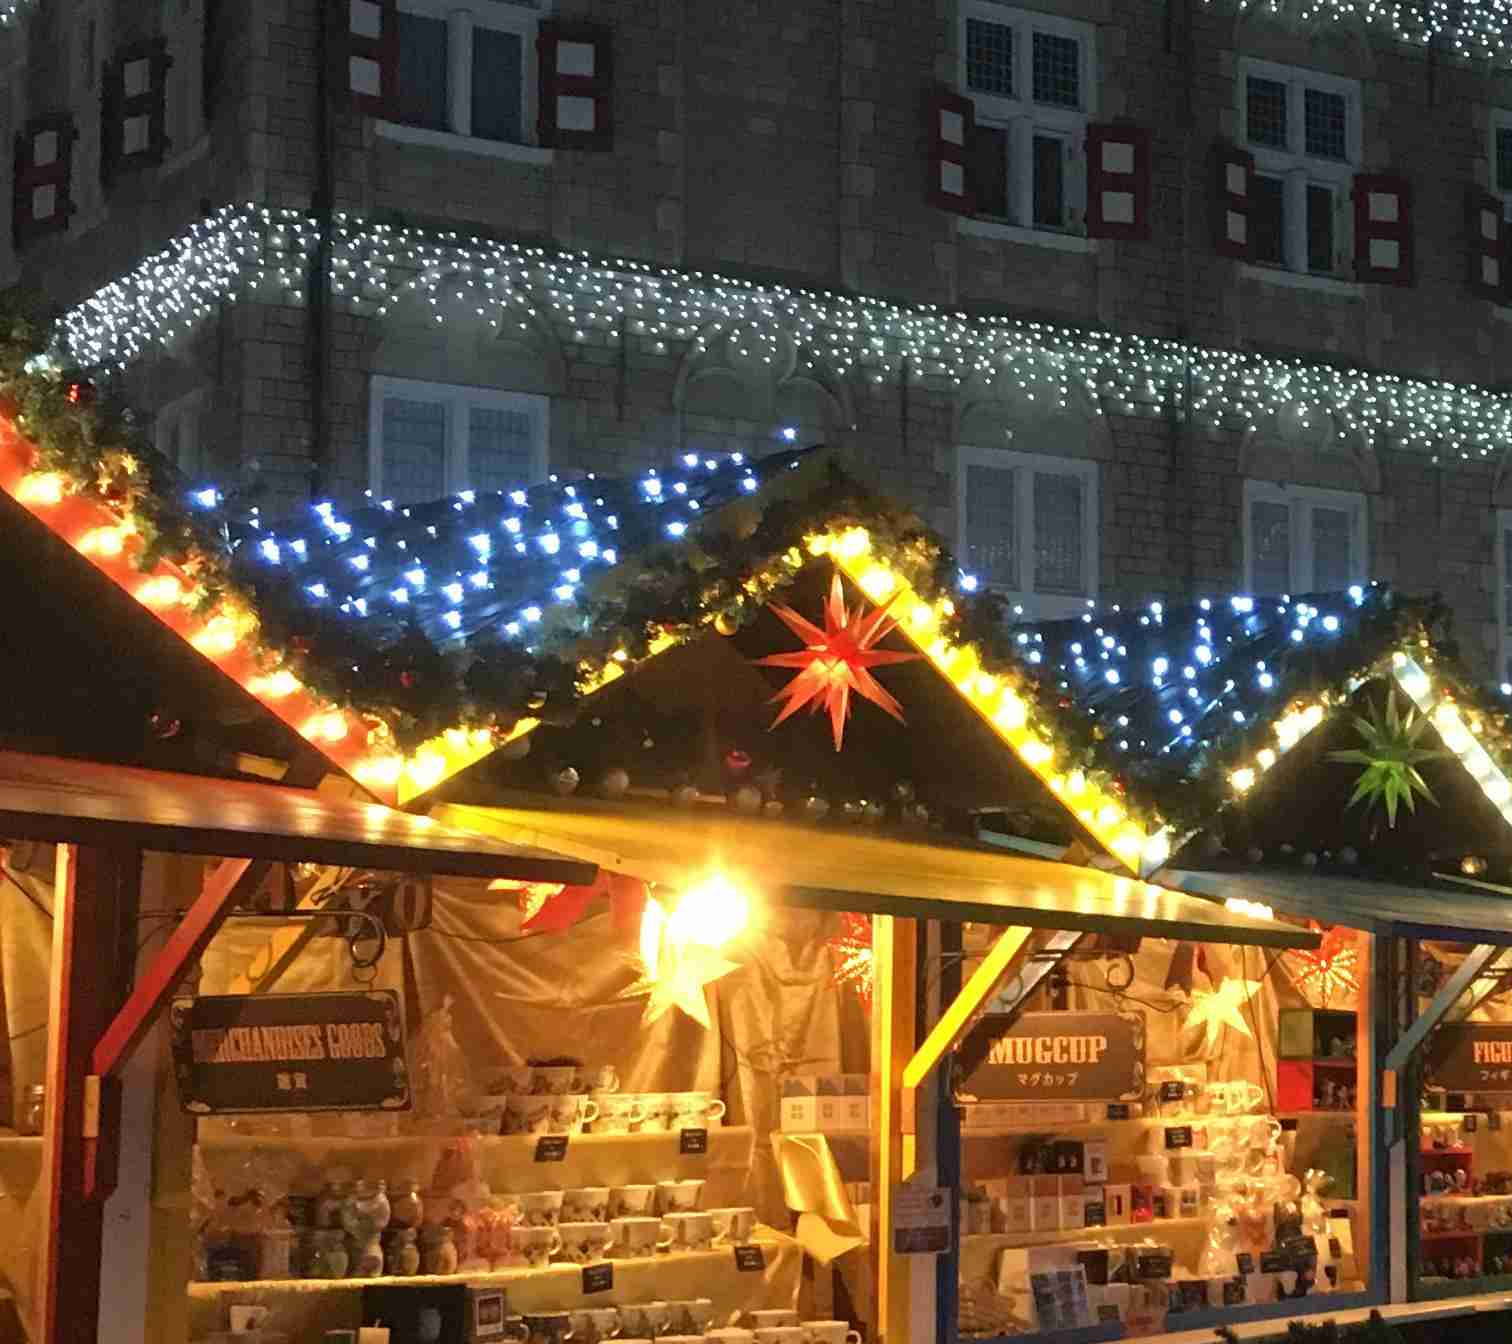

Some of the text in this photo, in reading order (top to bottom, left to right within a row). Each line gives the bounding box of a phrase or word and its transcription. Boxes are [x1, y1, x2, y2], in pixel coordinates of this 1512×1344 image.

[987, 1035, 1107, 1065] MUGCUP
[1016, 1072, 1079, 1086] マグカップ
